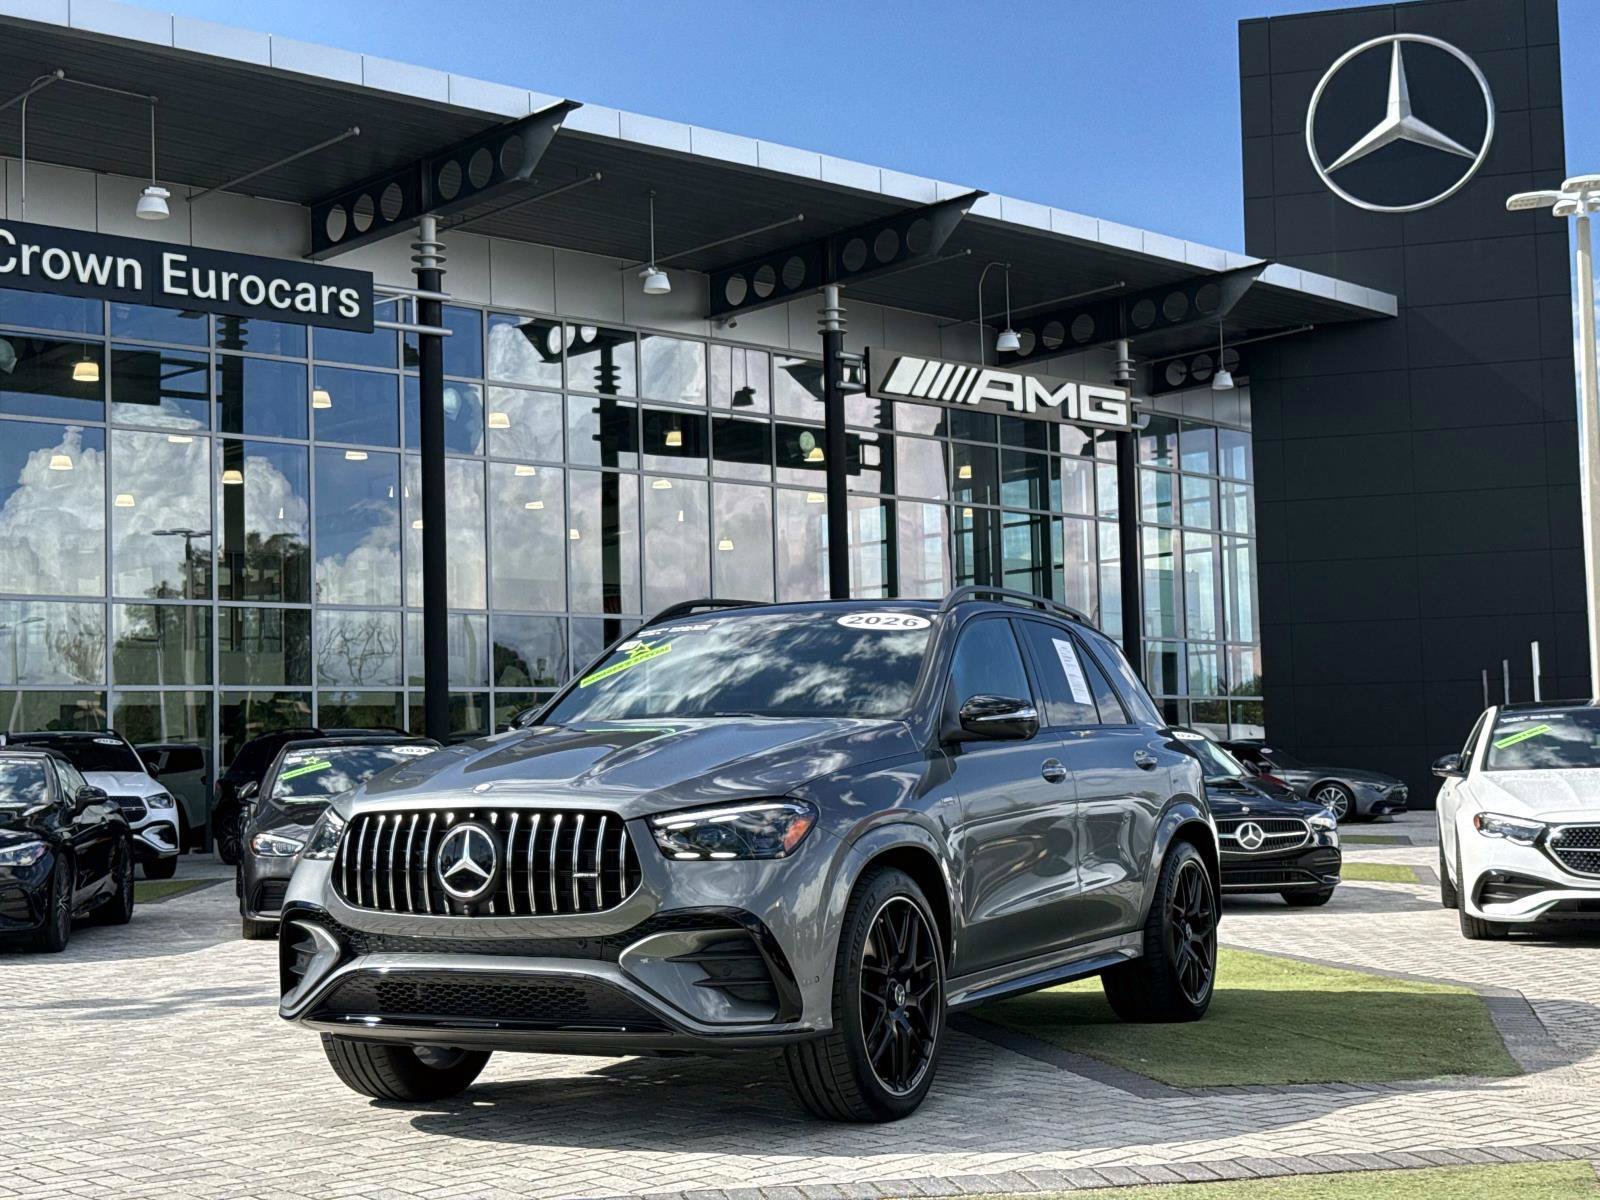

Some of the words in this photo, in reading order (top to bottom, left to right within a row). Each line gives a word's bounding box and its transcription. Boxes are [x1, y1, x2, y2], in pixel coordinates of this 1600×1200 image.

[162, 251, 361, 319] Eurocars
[966, 368, 1128, 427] AMG
[846, 615, 920, 627] 2026
